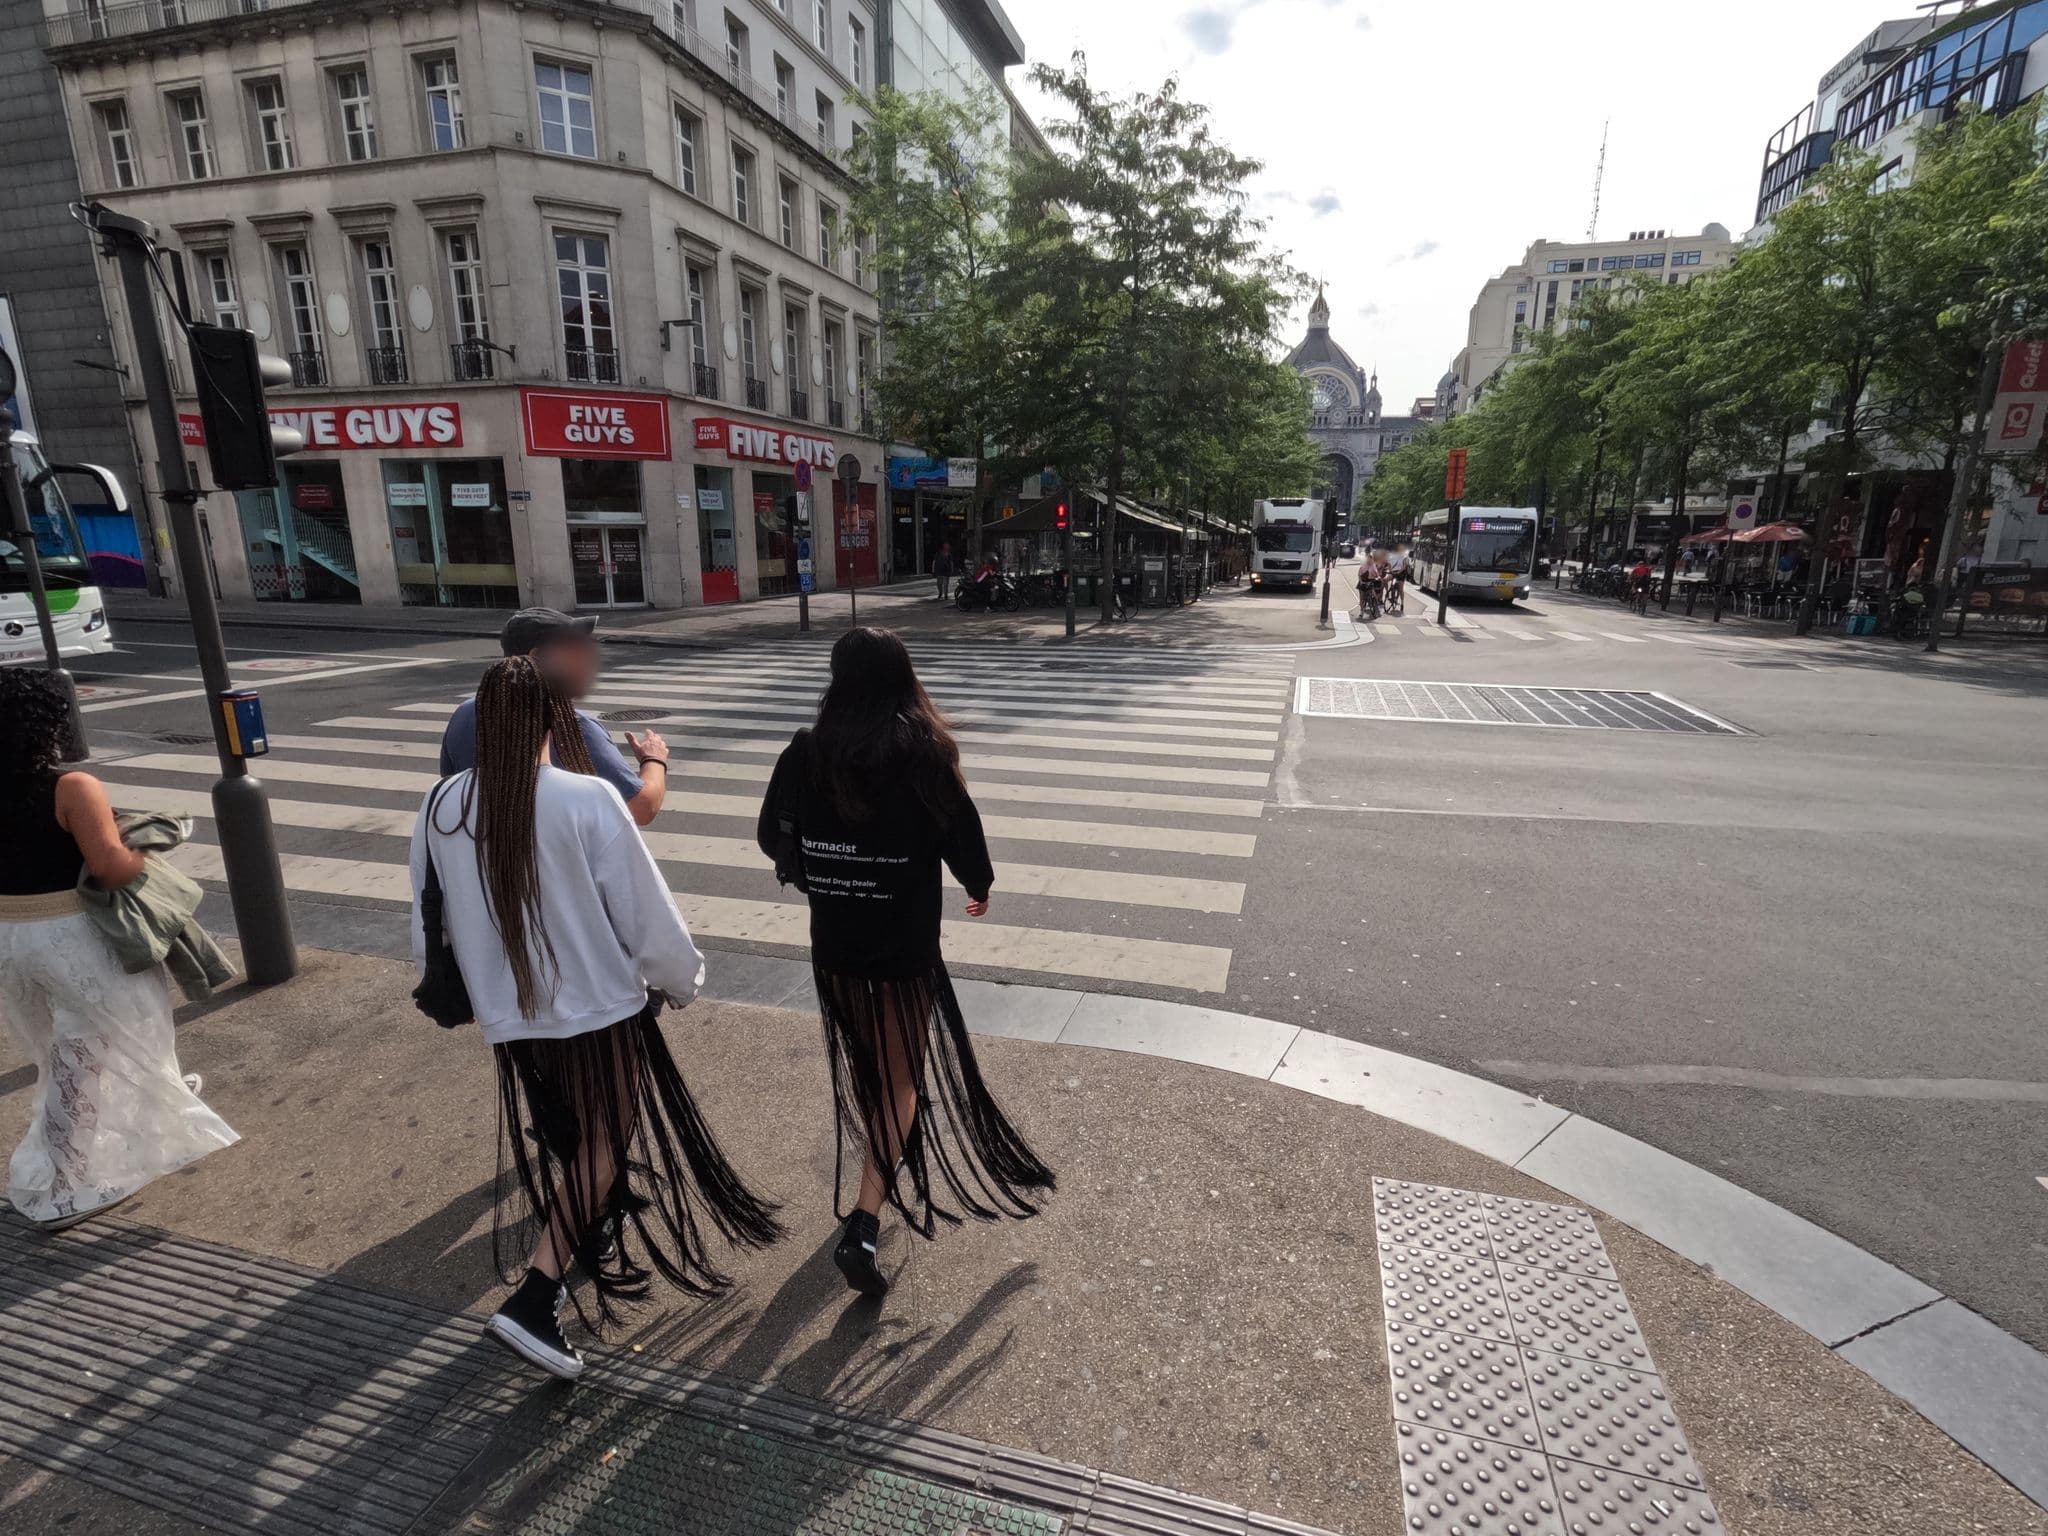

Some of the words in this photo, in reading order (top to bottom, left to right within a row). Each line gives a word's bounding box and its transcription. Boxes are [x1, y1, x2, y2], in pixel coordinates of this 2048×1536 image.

[569, 405, 626, 425] FIVE
[345, 406, 457, 445] GUYS
[564, 424, 635, 444] GUYS
[700, 425, 717, 433] FIVE
[698, 432, 720, 440] GUYS
[729, 424, 781, 461] FIVE
[783, 434, 837, 469] GUYS
[802, 836, 857, 853] harmacist
[806, 873, 832, 884] ucated
[832, 878, 851, 888] Drug
[852, 879, 877, 888] Dealer
